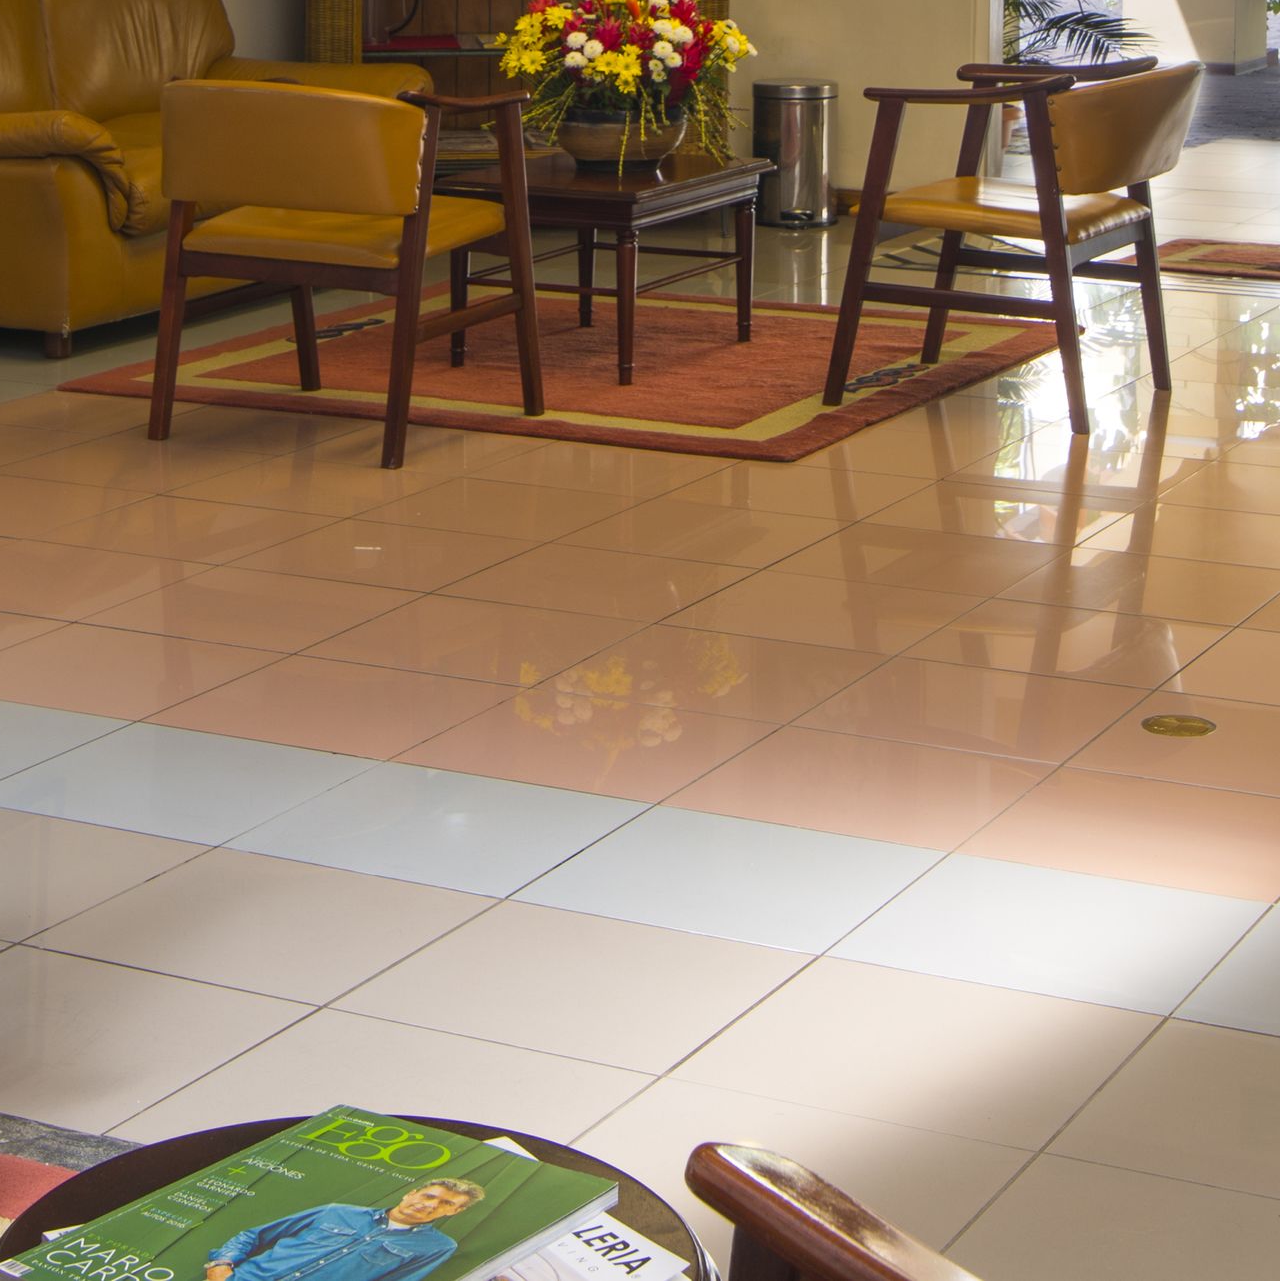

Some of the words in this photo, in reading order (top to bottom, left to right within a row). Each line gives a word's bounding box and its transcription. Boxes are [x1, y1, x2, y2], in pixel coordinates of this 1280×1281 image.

[196, 1182, 237, 1197] GARNIER
[203, 1178, 256, 1196] LEONARDO
[64, 1238, 174, 1281] MARIO
